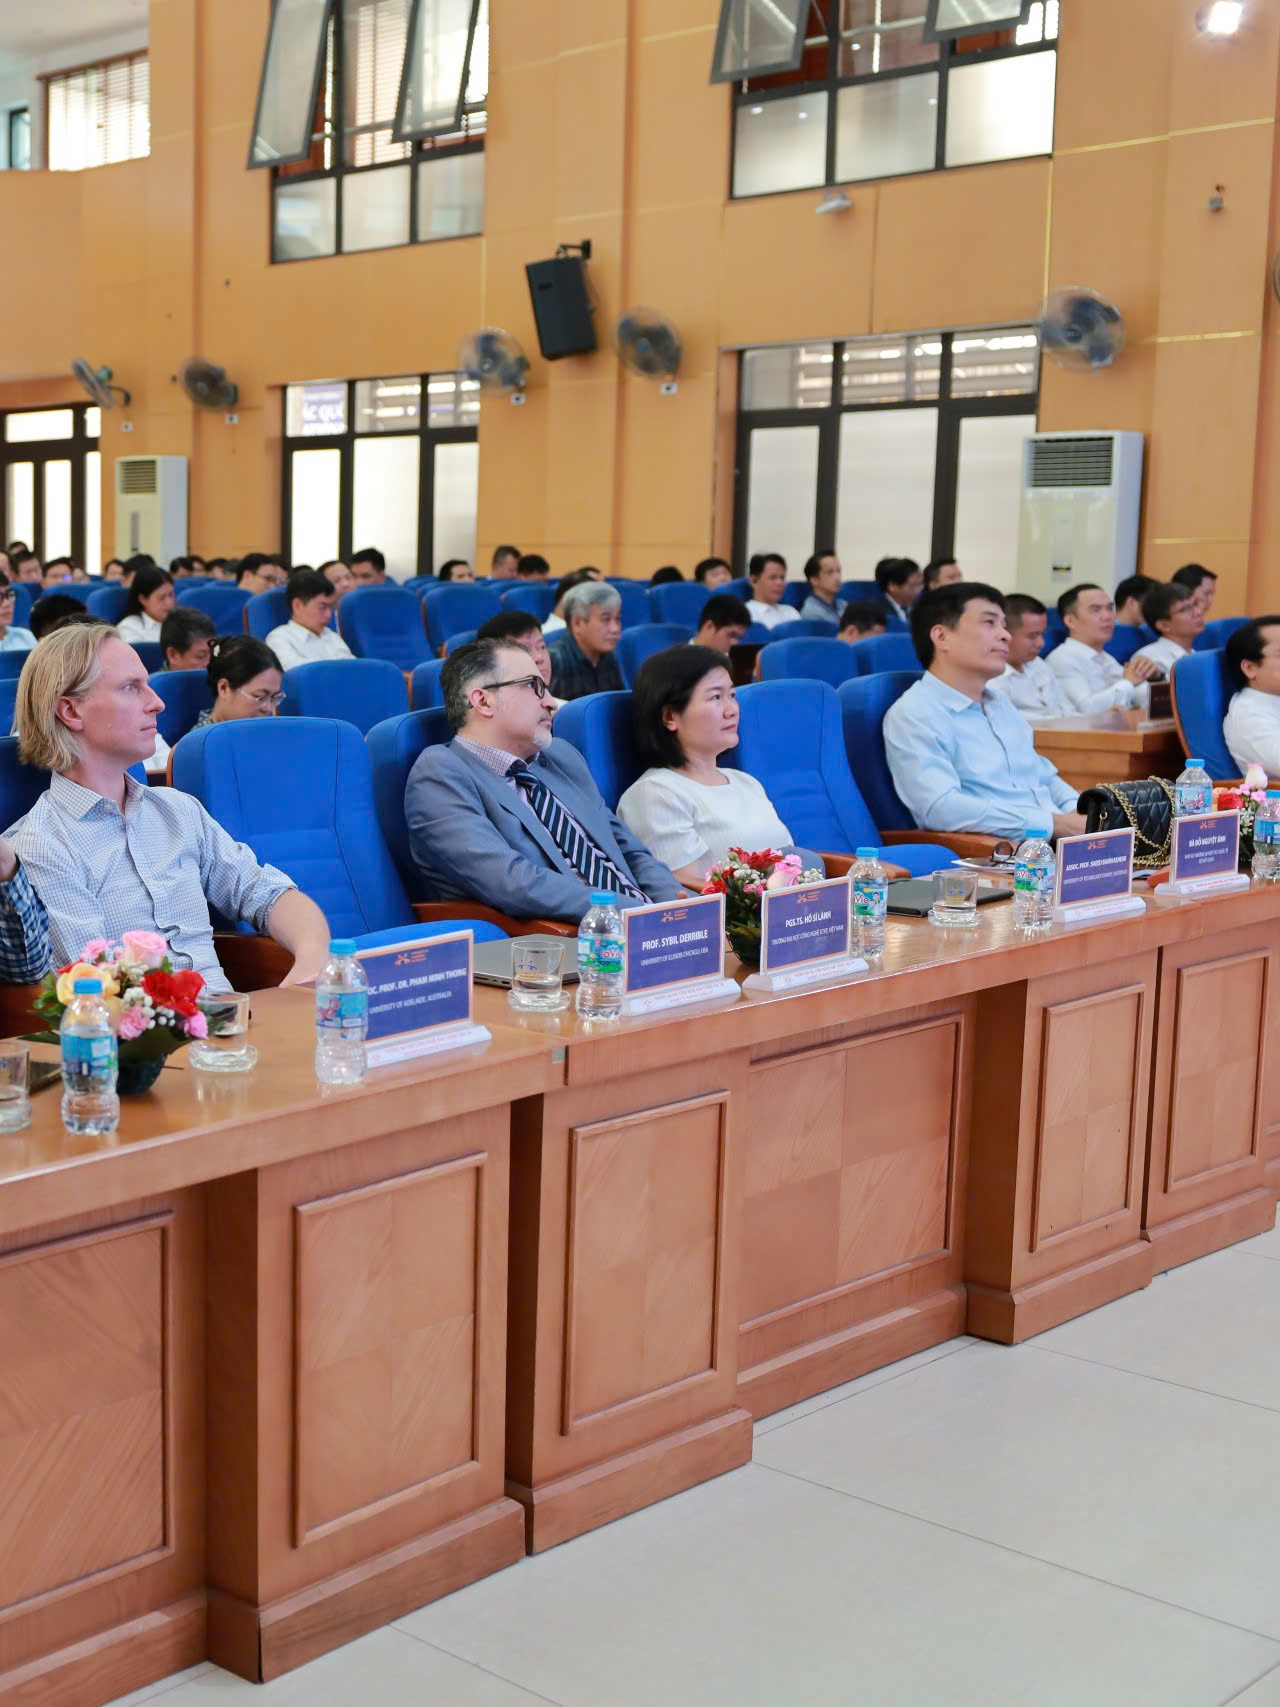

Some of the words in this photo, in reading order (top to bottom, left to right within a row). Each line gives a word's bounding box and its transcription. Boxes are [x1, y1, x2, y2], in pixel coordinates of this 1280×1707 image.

[642, 938, 661, 951] PROF.
[662, 935, 678, 947] SYBIL
[679, 929, 708, 944] DERRIBLE
